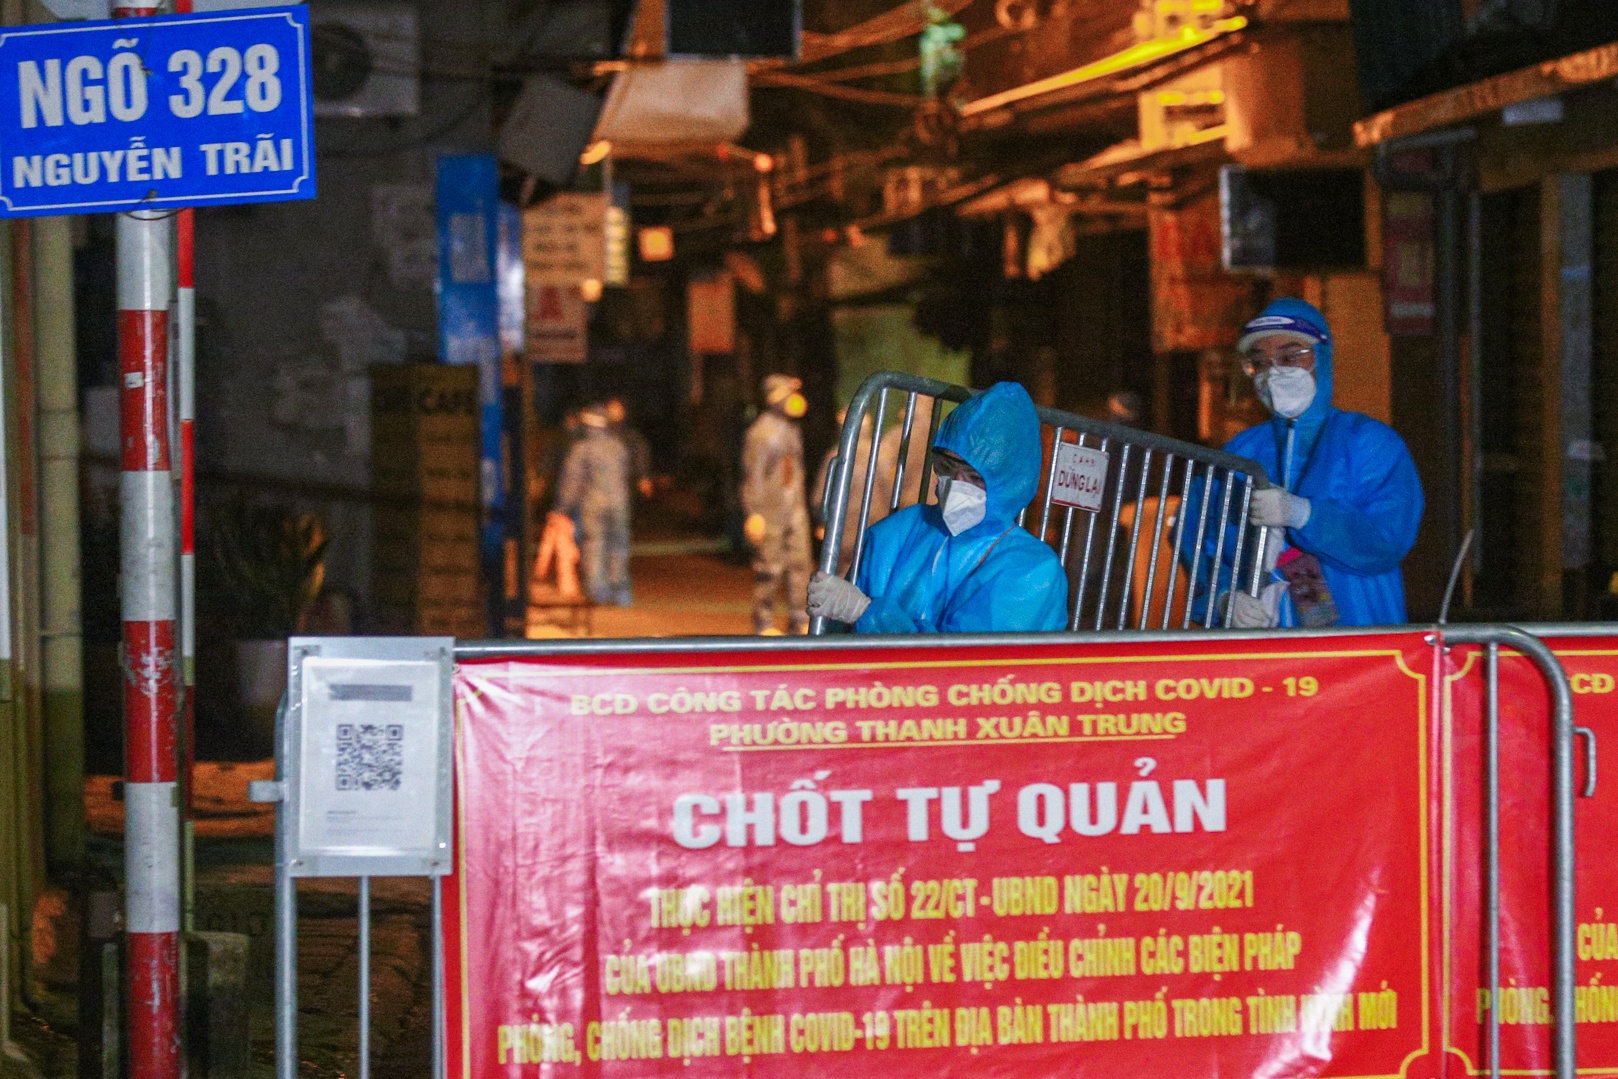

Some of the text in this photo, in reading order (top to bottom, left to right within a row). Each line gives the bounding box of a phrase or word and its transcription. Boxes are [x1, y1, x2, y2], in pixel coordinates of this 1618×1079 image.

[18, 38, 282, 128] NGÕ 328
[12, 132, 294, 188] NGUYỄN TRÃI
[648, 687, 741, 714] CÔNG
[750, 683, 817, 711] TÁC
[824, 681, 940, 710] PHÒNG
[947, 674, 1062, 706] CHỐNG
[1070, 680, 1147, 708] DỊCH
[1155, 677, 1254, 700] COVID
[1282, 676, 1318, 696] 19
[709, 711, 1187, 746] PHƯỜNG THANH XUÂN TRUNG
[672, 757, 1227, 852] CHỐT TỰ QUẢN
[716, 877, 774, 934] HIỆN
[780, 868, 823, 924] CHỈ
[827, 882, 866, 930] THỊ
[871, 867, 906, 920] SỐ
[1064, 866, 1129, 913] NGÀY
[1134, 870, 1254, 911] 20/9/2021
[604, 938, 652, 995] CỦA
[722, 942, 795, 990] THÀNH
[799, 933, 845, 988] PHỐ
[849, 938, 880, 985] HÀ
[884, 936, 924, 992] NỘI
[928, 930, 957, 983] VỀ
[959, 934, 1010, 989] VIỆC
[1069, 923, 1136, 978] CHỈNH
[1140, 928, 1184, 974] CÁC
[1188, 926, 1239, 981] BIỆN
[1244, 923, 1302, 971] PHÁP
[586, 1006, 663, 1062] CHỐNG
[667, 1017, 720, 1066] DỊCH
[725, 1007, 786, 1064] BỆNH
[790, 1011, 890, 1053] COVID-19
[894, 1000, 950, 1049] TRÊN
[997, 997, 1043, 1045] BÀN
[1047, 994, 1119, 1042] THÀNH
[1123, 986, 1168, 1040] PHỐ
[1171, 997, 1243, 1038] TRONG
[1246, 988, 1297, 1035] TÌNH
[1358, 980, 1398, 1030] MỚI
